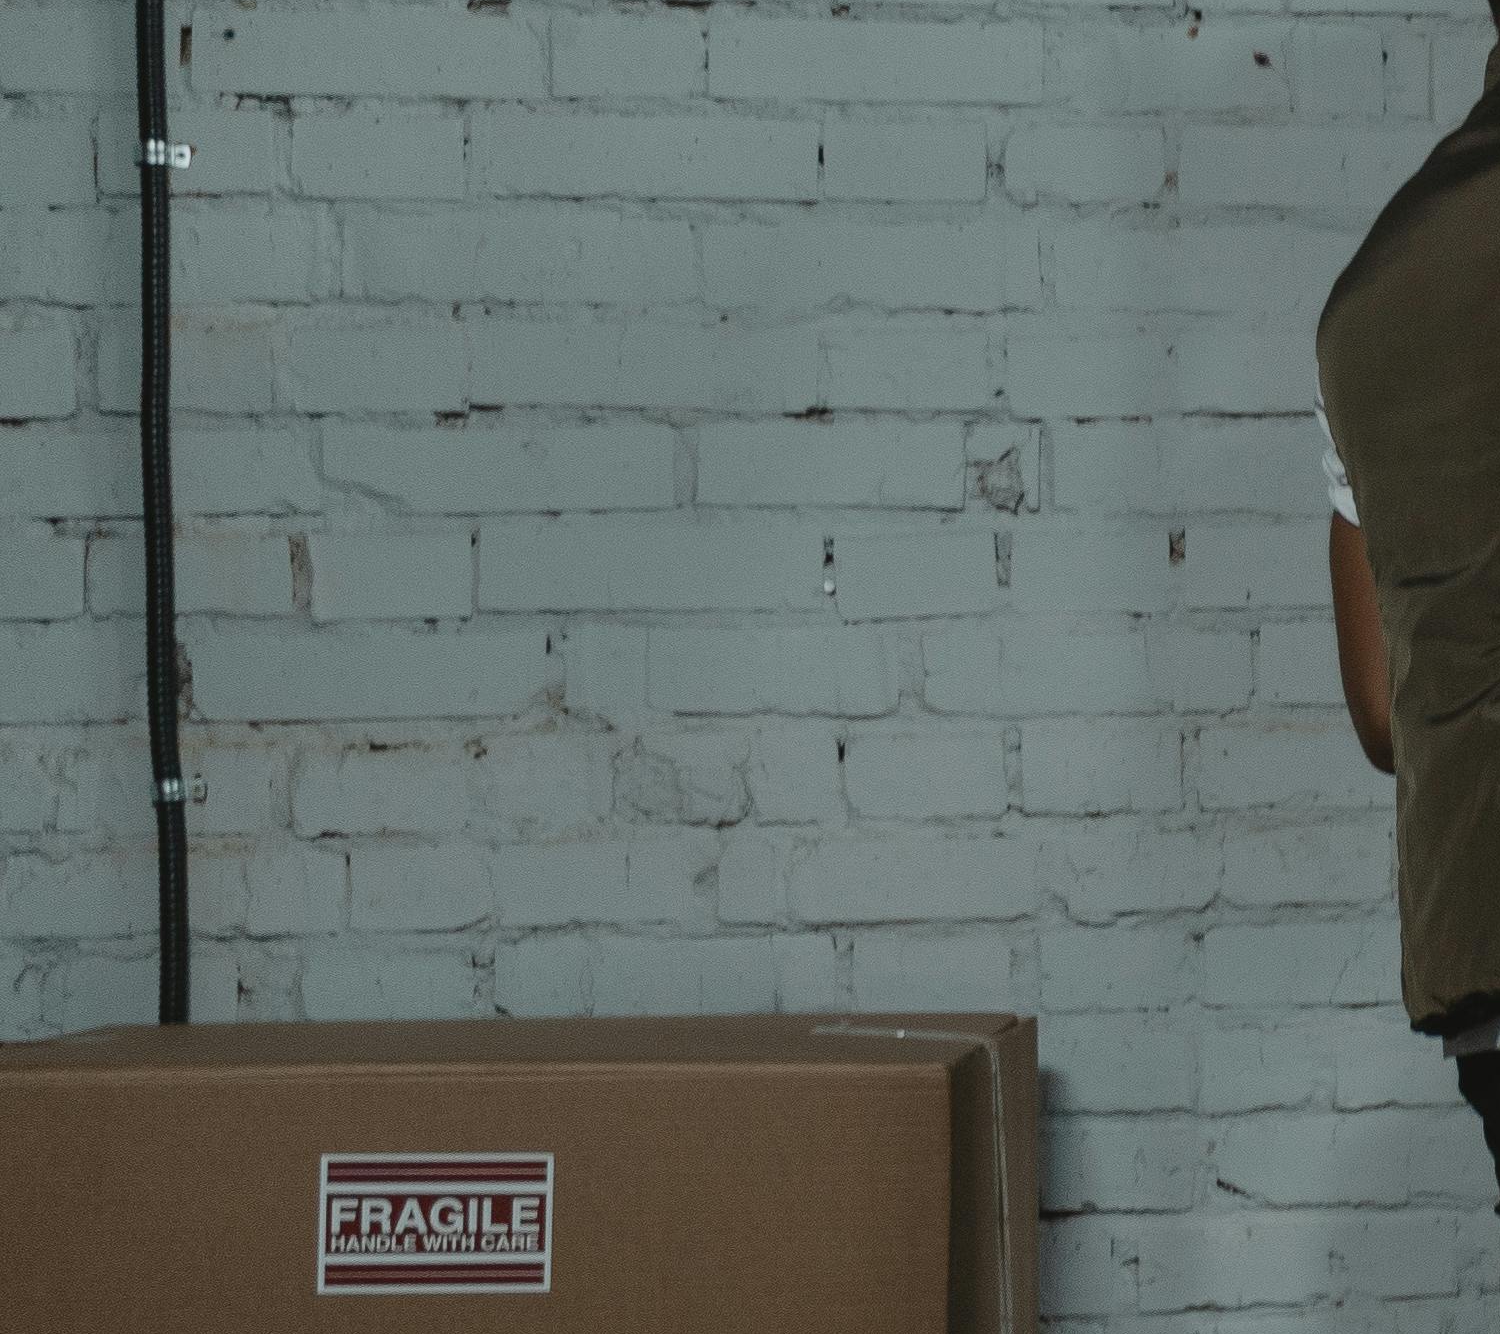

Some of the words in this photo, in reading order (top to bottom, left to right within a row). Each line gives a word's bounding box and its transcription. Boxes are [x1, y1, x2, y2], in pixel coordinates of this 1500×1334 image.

[330, 1197, 540, 1235] FRAGILE
[330, 1234, 416, 1253] HANDLE
[423, 1233, 475, 1252] WITH
[481, 1232, 539, 1252] CARE
